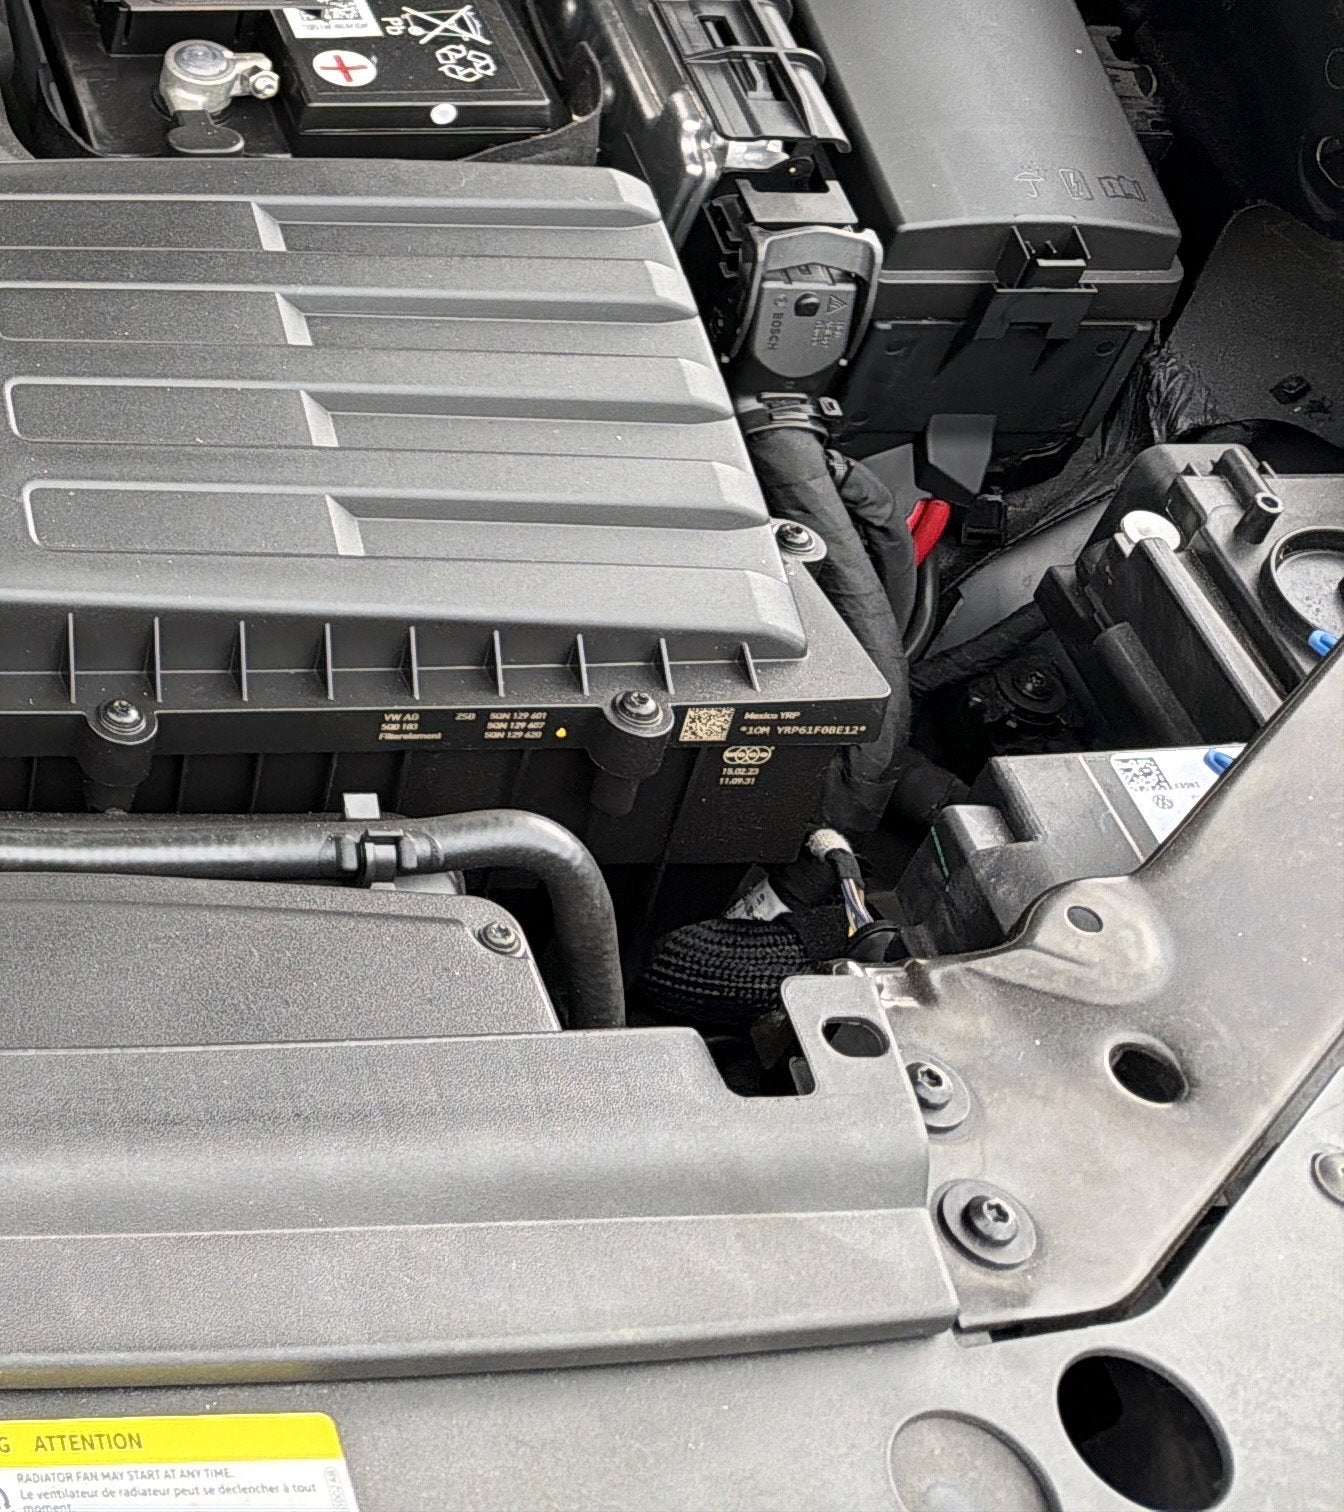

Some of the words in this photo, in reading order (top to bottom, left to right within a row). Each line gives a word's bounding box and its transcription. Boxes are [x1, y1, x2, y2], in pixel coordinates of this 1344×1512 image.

[381, 16, 407, 36] Pb
[767, 311, 784, 352] BOSCH
[744, 711, 779, 720] Mexico
[779, 711, 801, 720] YRP
[34, 1431, 143, 1454] ATTENTION
[16, 1471, 74, 1484] RADIATOR
[75, 1470, 99, 1482] FAN
[100, 1470, 124, 1481] MAY
[127, 1469, 160, 1481] START
[164, 1468, 177, 1480] AT
[179, 1468, 202, 1479] ANY
[20, 1489, 34, 1500] Le
[36, 1487, 98, 1500] ventilateur
[102, 1487, 116, 1498] de
[119, 1486, 170, 1497] radiateur
[174, 1486, 200, 1498] peut
[203, 1487, 215, 1496] se
[293, 1483, 317, 1493] tout
